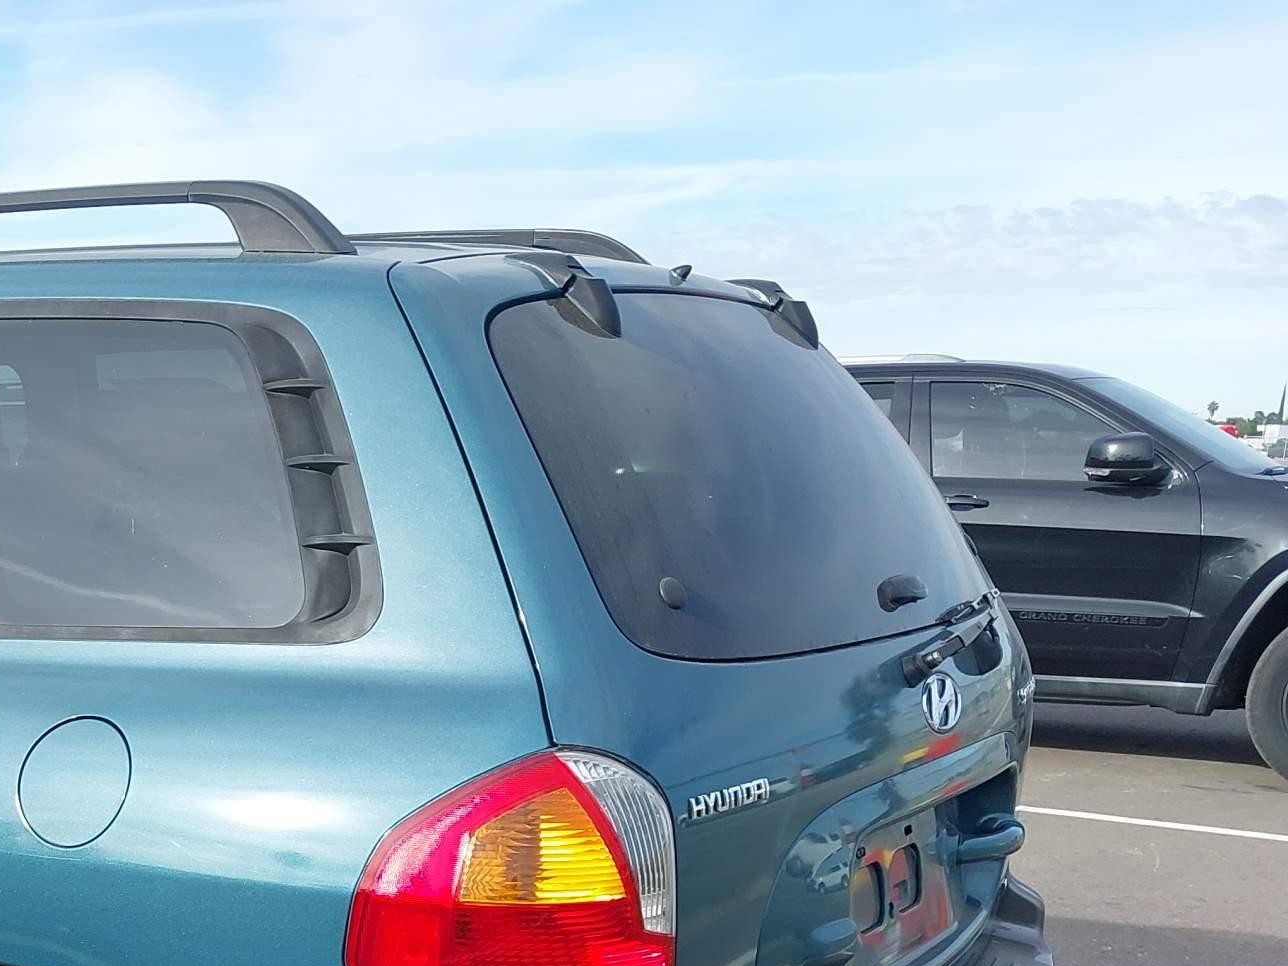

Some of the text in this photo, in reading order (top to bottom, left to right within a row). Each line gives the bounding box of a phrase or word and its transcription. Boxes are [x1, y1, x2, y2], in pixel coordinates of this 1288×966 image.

[1019, 610, 1148, 626] GRAND CHEROKEE
[688, 777, 770, 820] HYUNDAI
